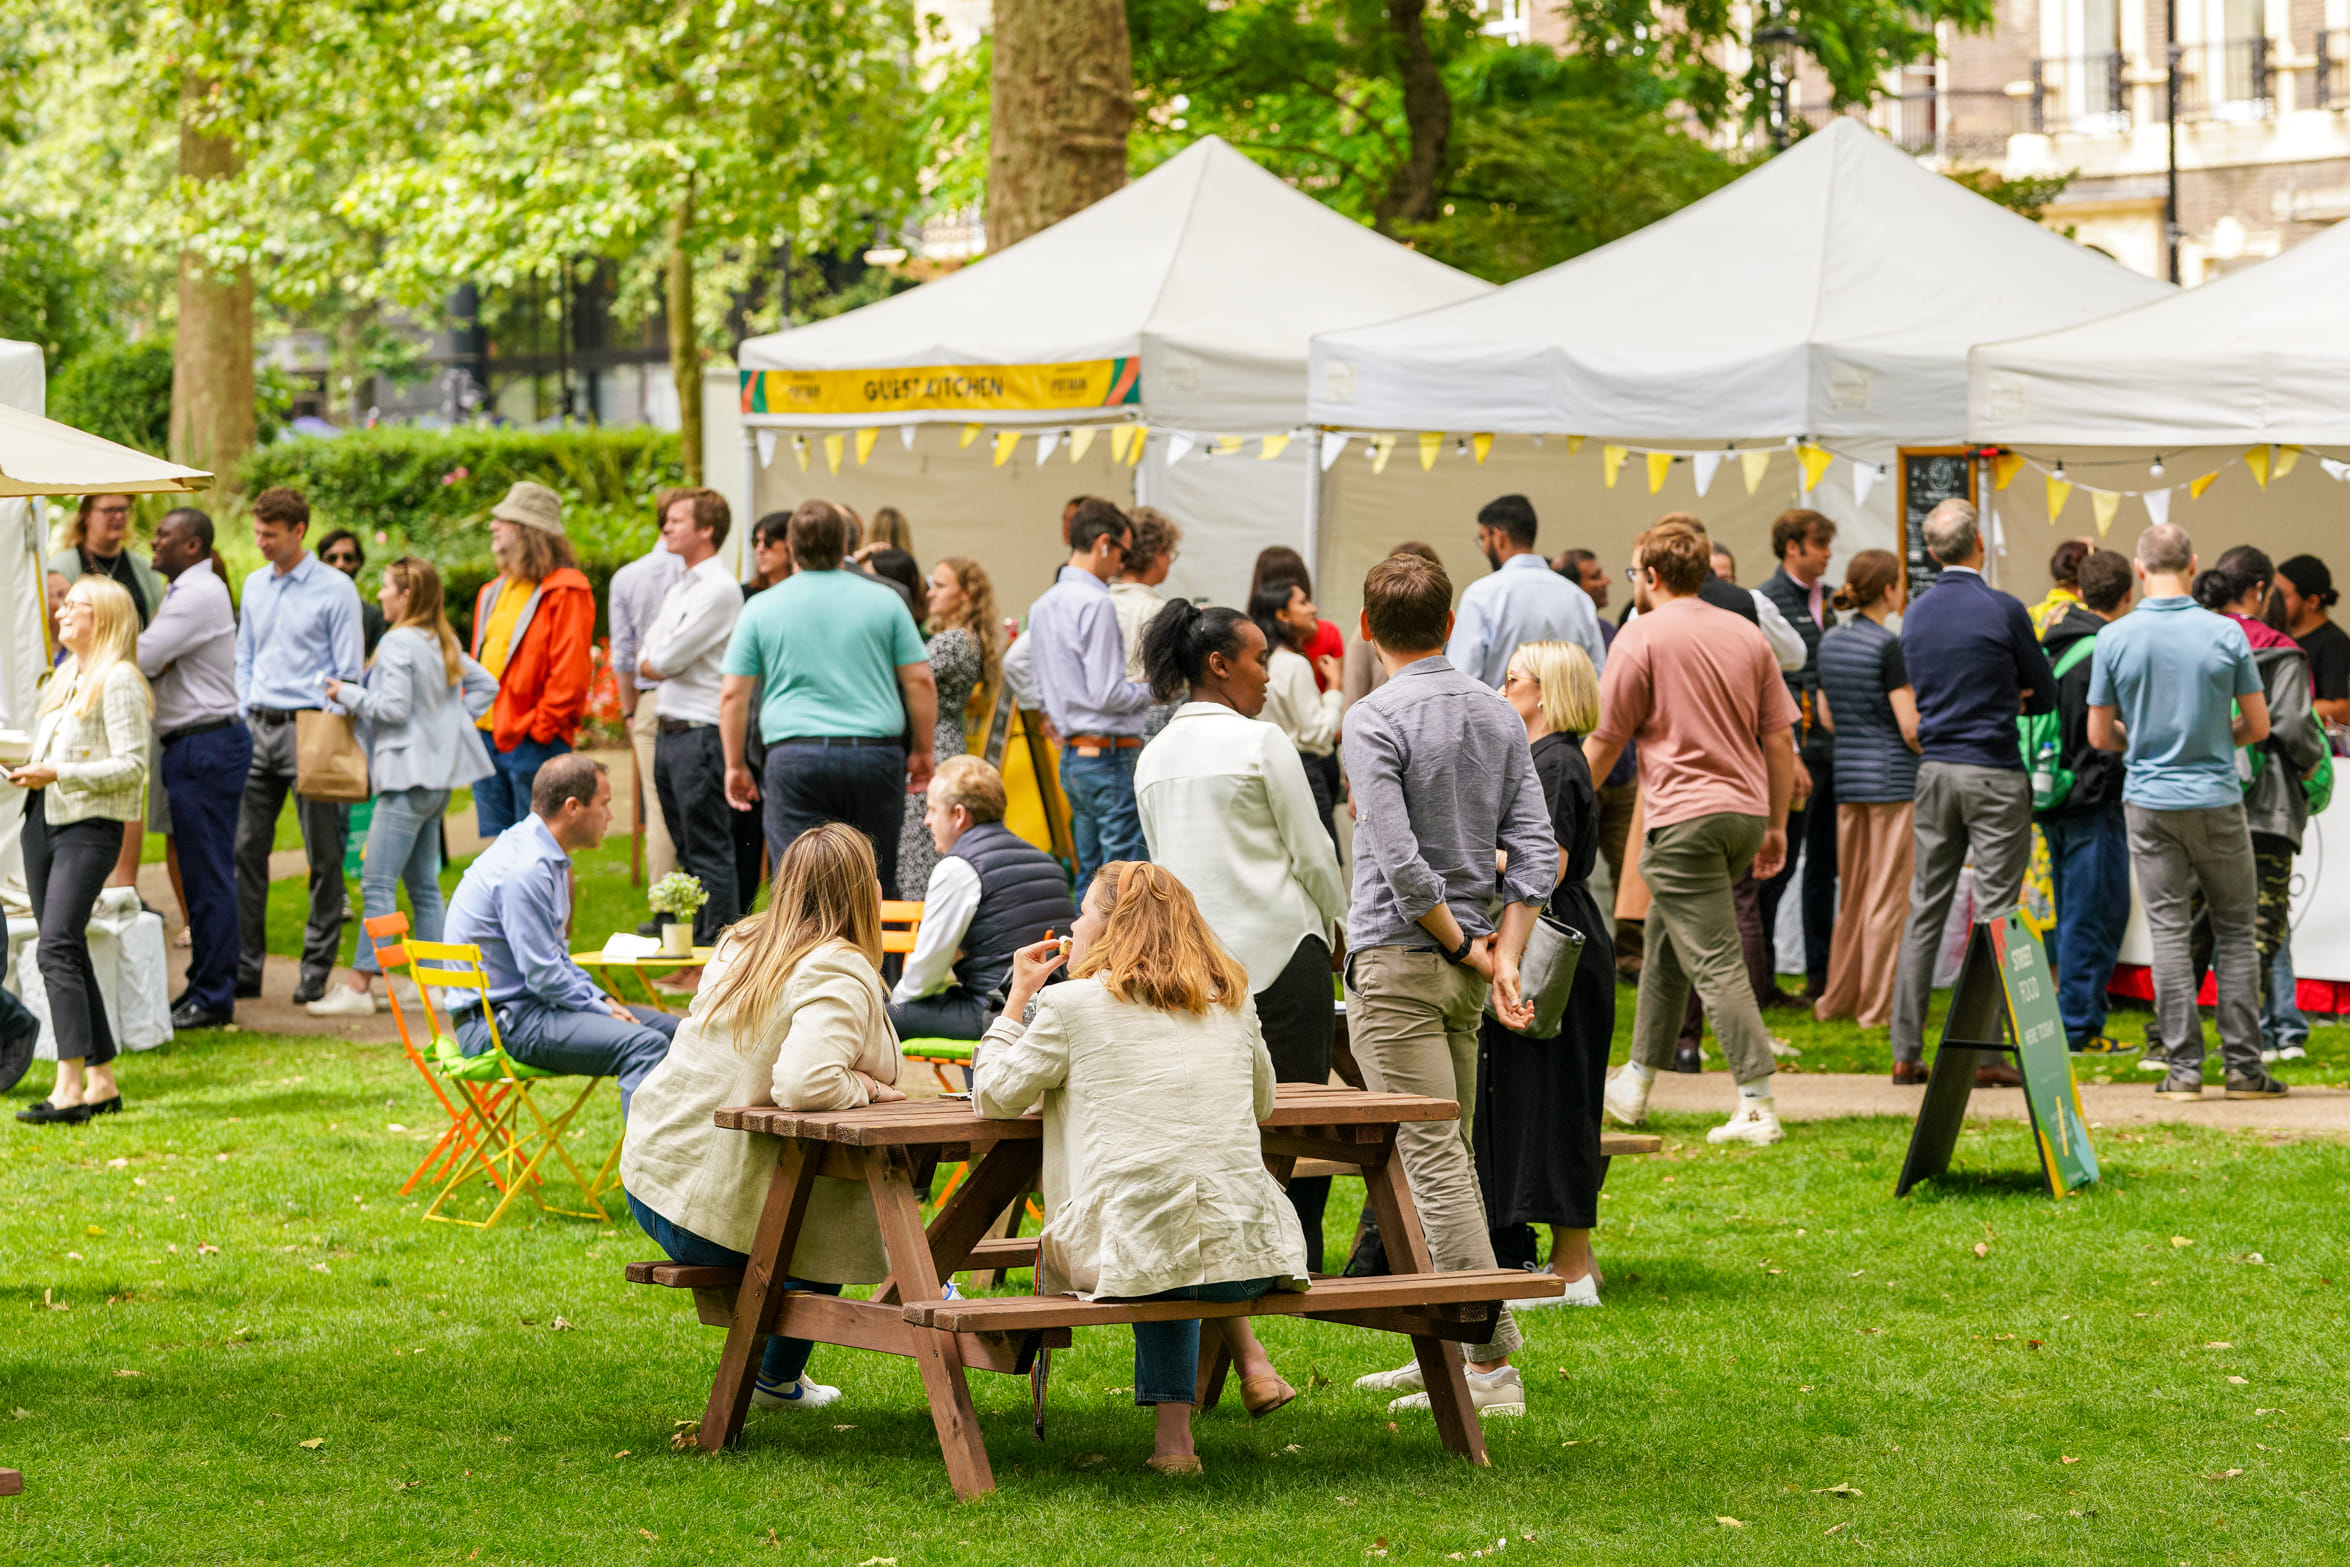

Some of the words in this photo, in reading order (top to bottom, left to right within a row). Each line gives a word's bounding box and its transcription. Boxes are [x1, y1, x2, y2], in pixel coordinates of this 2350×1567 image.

[865, 378, 919, 401] GUEST
[926, 376, 1004, 398] KITCHEN
[2011, 944, 2034, 972] STREET
[2018, 976, 2040, 1003] FOOD
